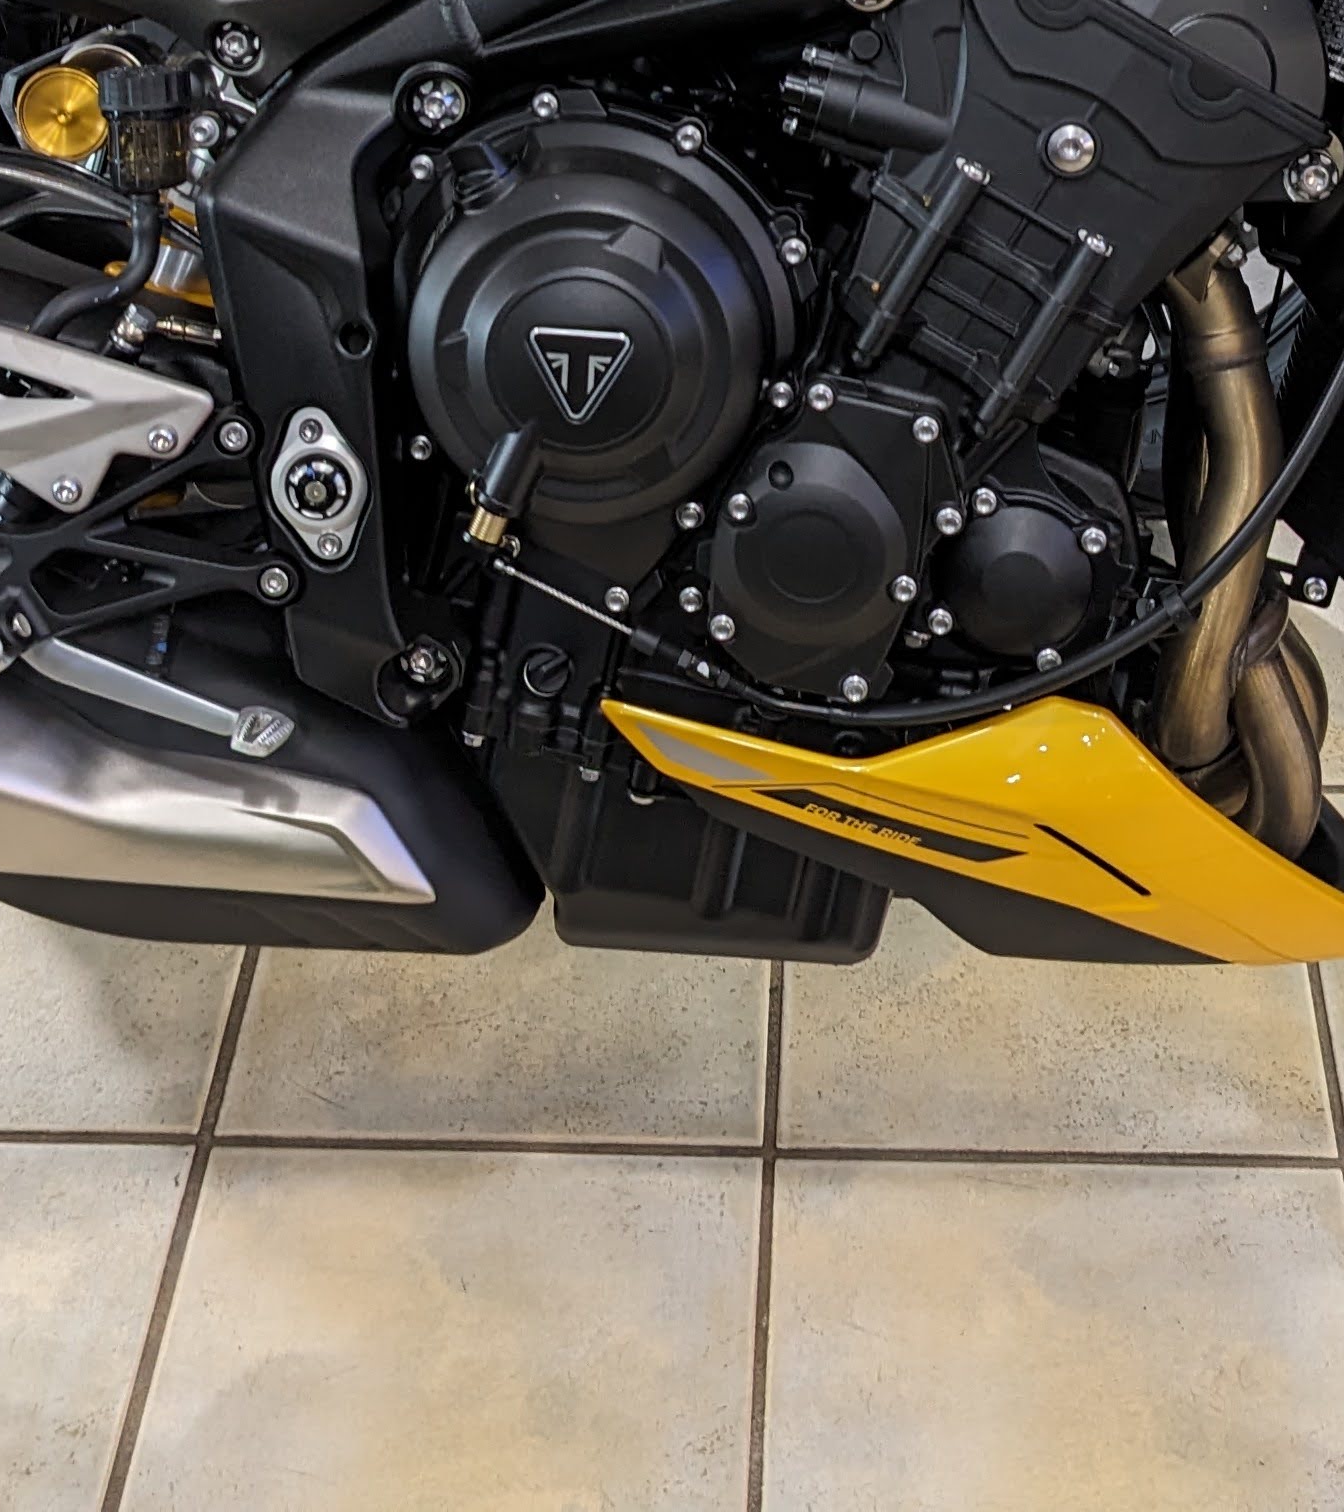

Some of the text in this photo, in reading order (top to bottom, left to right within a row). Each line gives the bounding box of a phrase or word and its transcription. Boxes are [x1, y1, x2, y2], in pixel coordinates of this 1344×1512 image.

[805, 802, 923, 847] FOR THE RIDE
